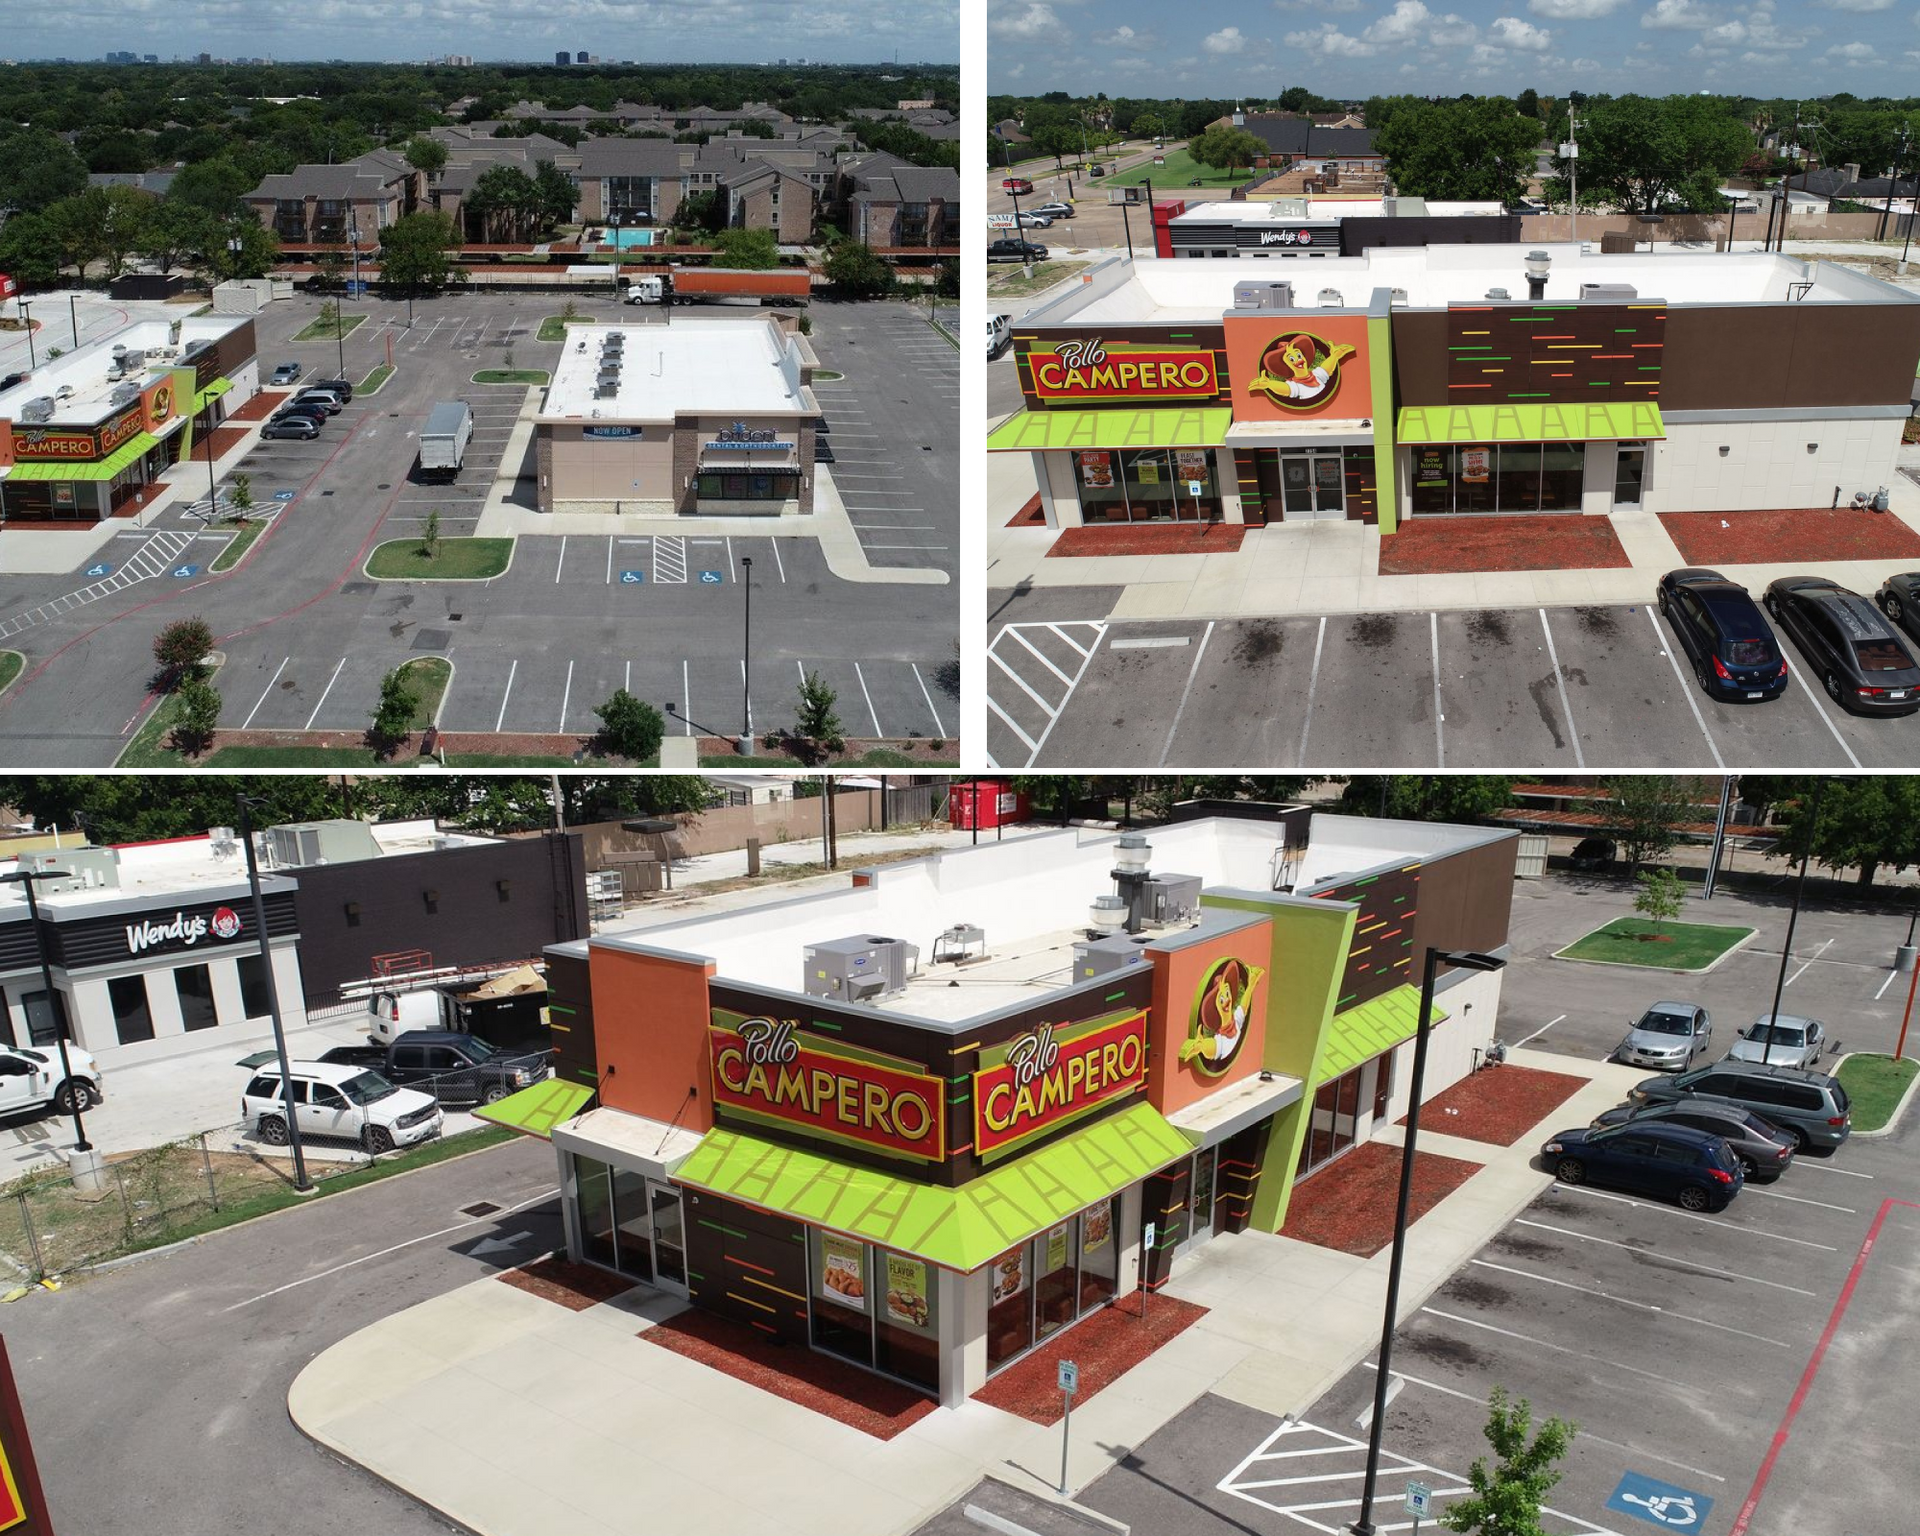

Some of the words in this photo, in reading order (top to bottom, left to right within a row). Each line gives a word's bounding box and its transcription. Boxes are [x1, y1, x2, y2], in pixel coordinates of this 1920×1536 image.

[1260, 230, 1297, 245] Wendy's
[1054, 338, 1107, 371] Pollo
[1038, 362, 1211, 389] CAMPERO
[15, 440, 92, 454] CAMPERO
[103, 414, 142, 447] CAMPERO
[593, 426, 609, 435] NOW
[611, 426, 632, 435] OPEN
[126, 912, 207, 953] Wendy's
[738, 1019, 798, 1065] Pollo
[1006, 1024, 1059, 1091] Pollo
[717, 1047, 934, 1141] CAMPERO
[984, 1033, 1142, 1132] CAMPERO
[889, 1264, 916, 1279] FLAVOR
